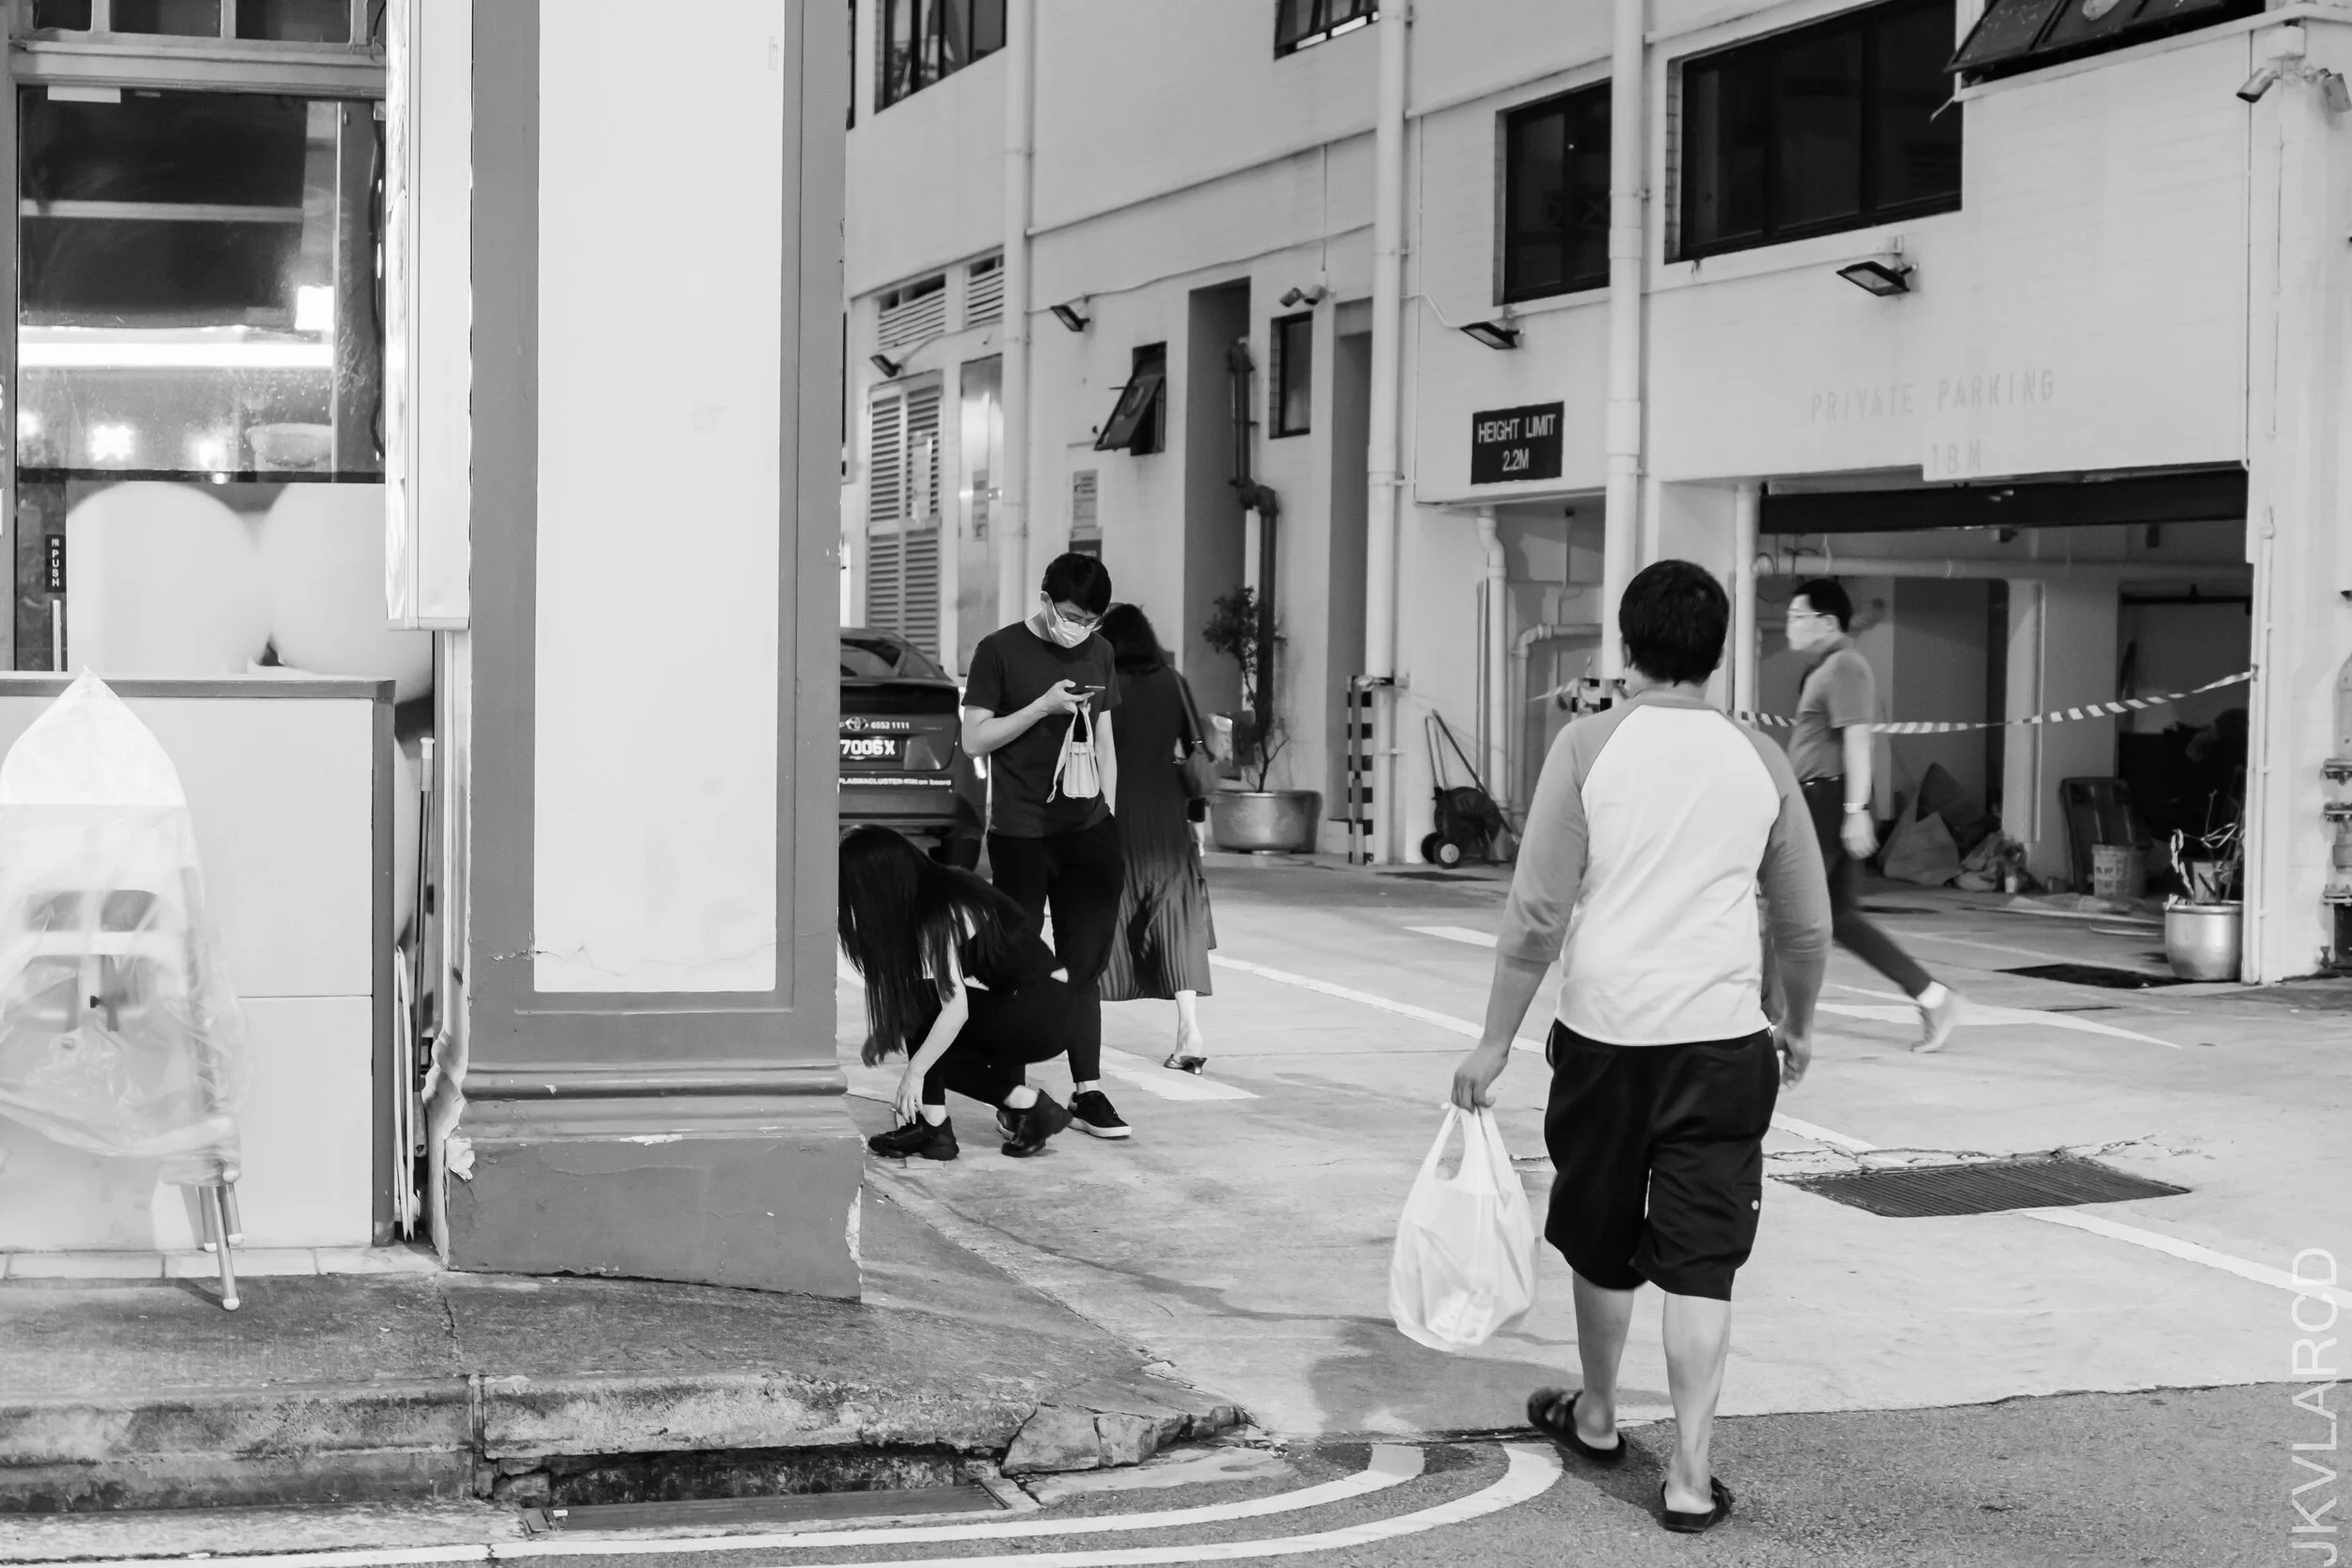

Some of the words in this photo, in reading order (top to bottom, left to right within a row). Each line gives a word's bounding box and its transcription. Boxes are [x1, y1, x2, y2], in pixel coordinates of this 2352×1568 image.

[1811, 383, 1915, 423] PRIVATE
[1938, 368, 2054, 410] PARKING
[1478, 418, 1520, 443] HEIGHT
[1525, 414, 1556, 438] LIMIT
[840, 739, 896, 755] 7006X
